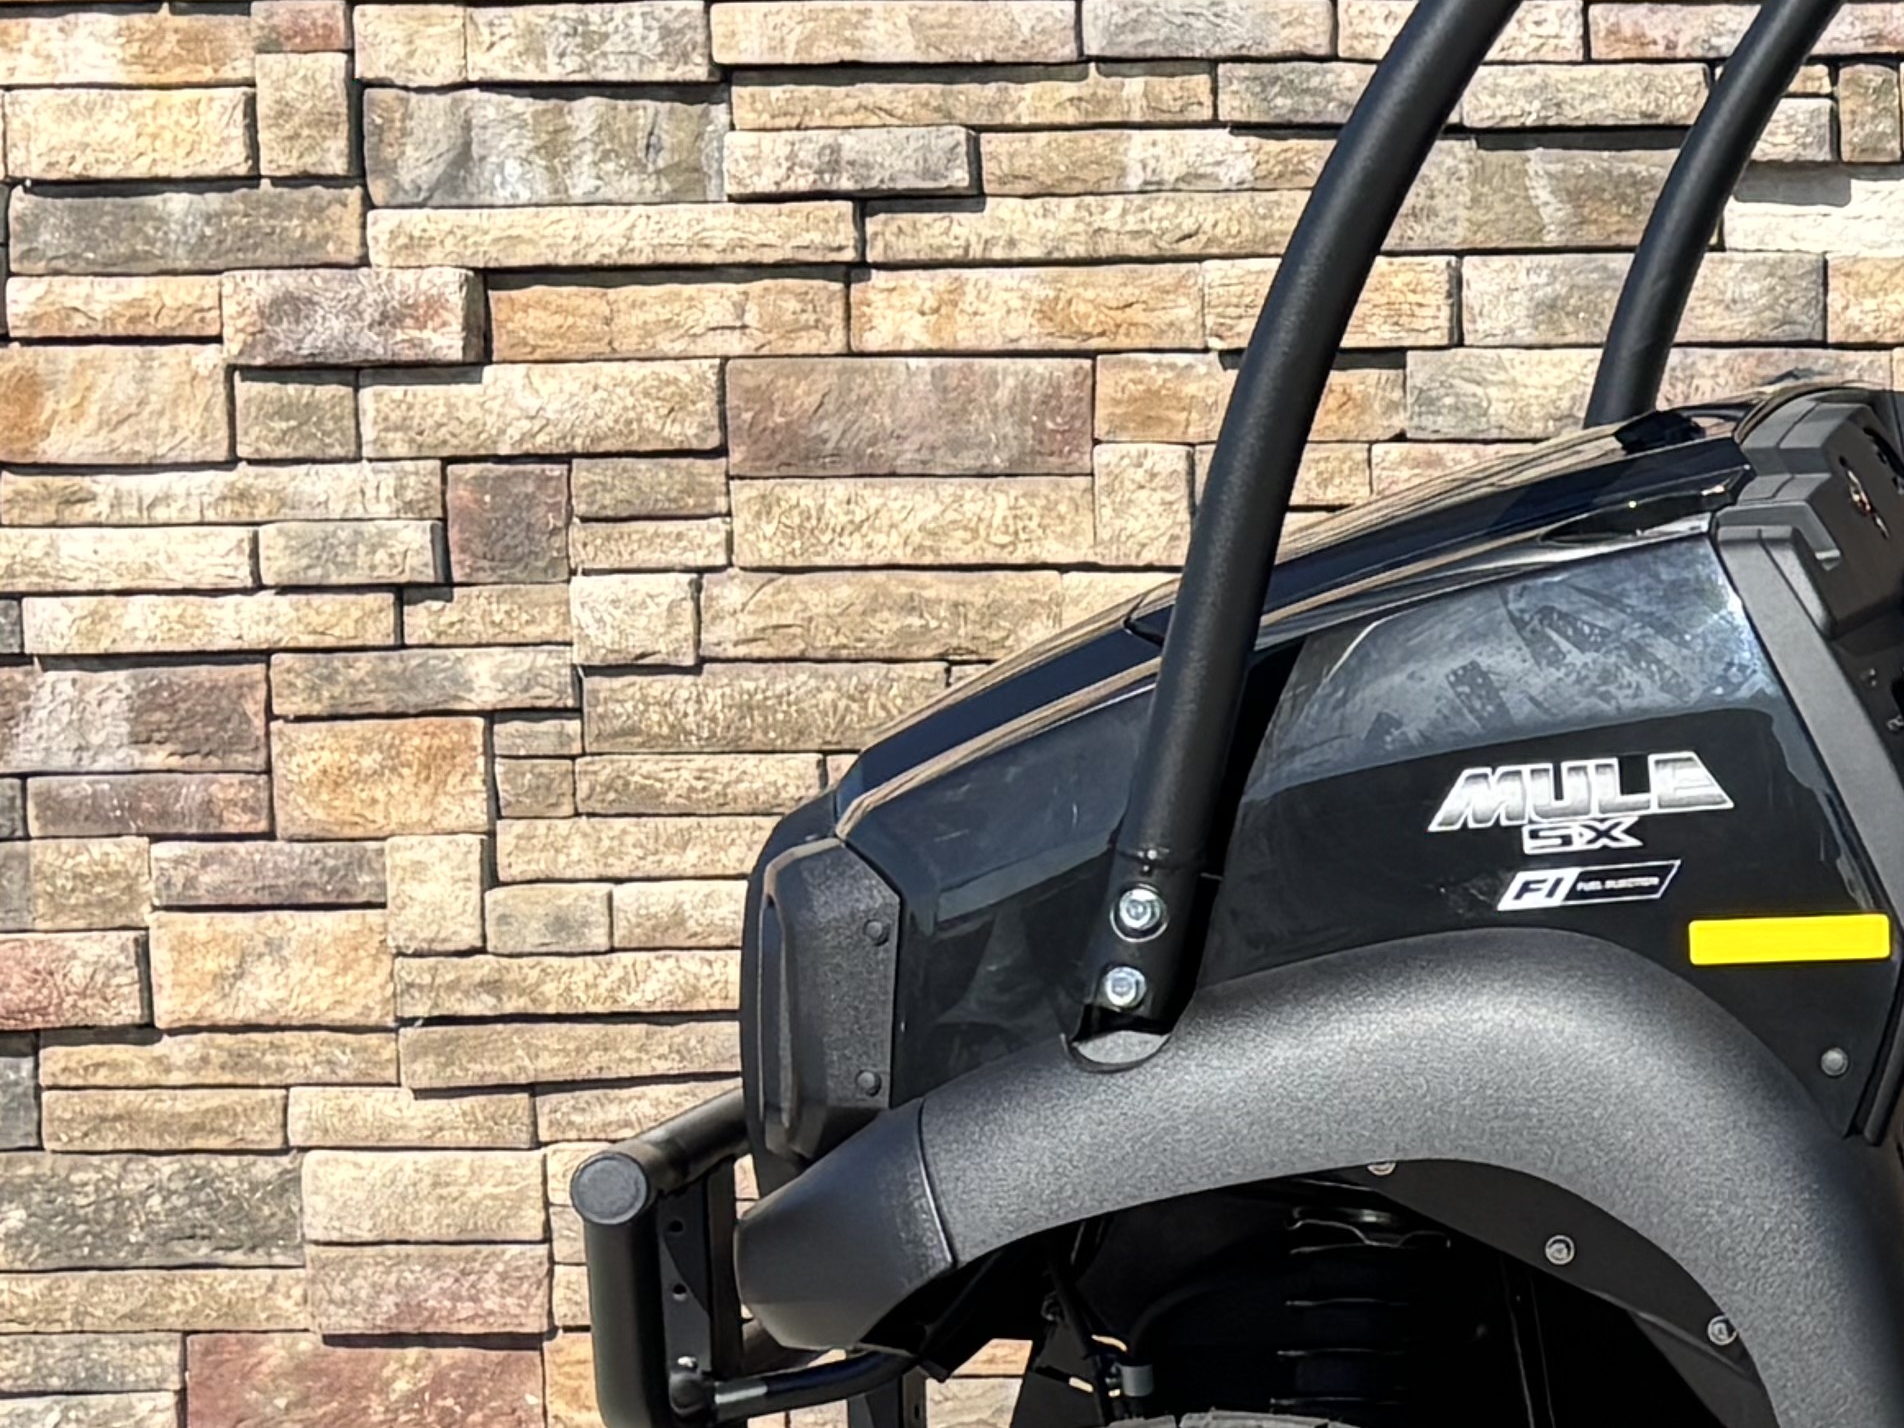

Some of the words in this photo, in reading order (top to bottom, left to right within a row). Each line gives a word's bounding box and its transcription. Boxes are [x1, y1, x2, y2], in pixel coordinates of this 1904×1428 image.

[1428, 751, 1734, 833] MULE
[1521, 817, 1644, 855] SX
[1513, 876, 1565, 901] FI
